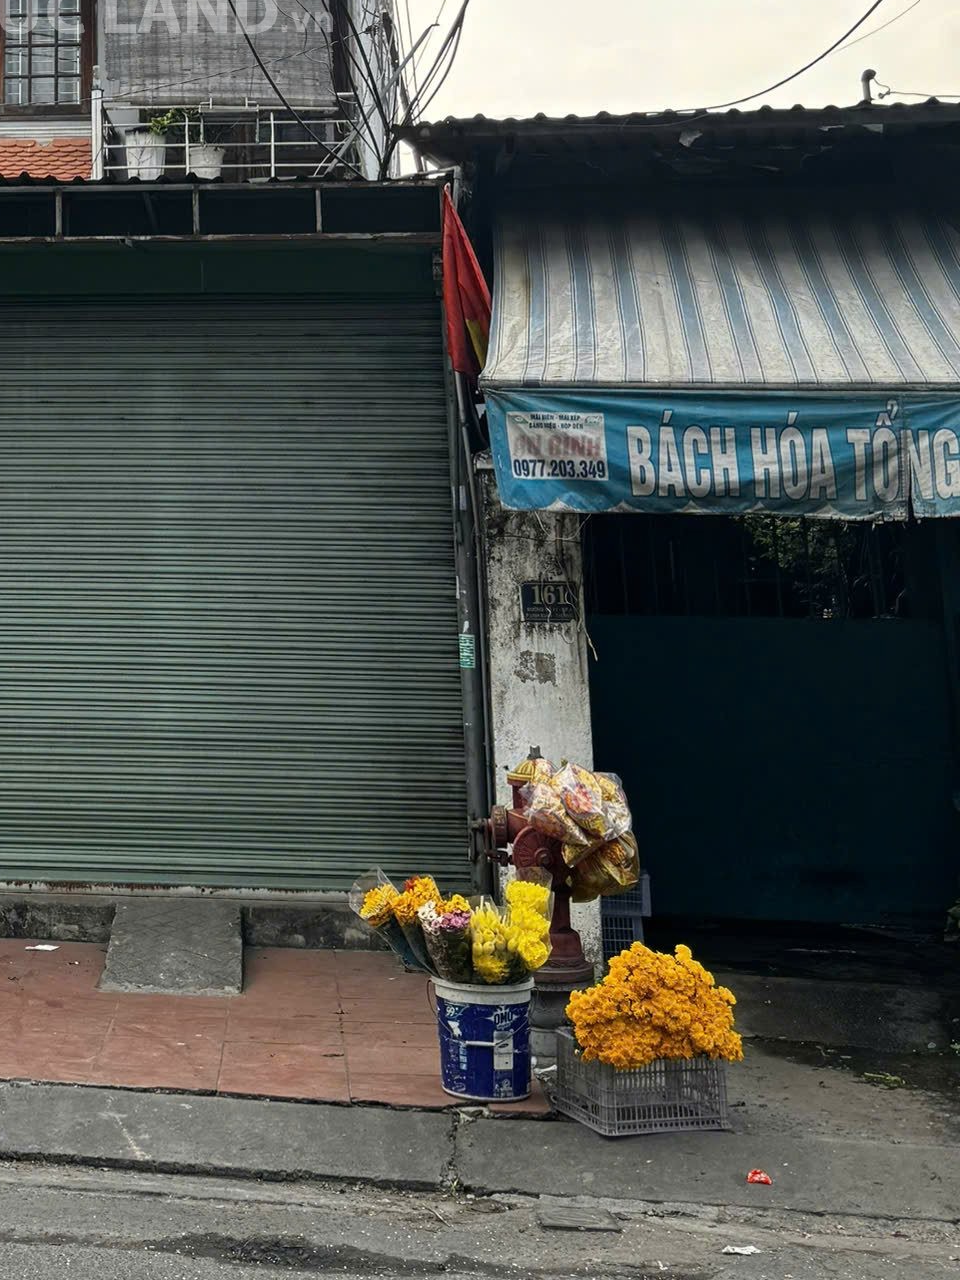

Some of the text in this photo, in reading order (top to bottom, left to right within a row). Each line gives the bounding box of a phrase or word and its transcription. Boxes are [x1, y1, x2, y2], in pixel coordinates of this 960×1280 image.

[626, 399, 960, 503] BÁCH HÓA TỔNG
[513, 459, 606, 479] 0977.203.349
[531, 585, 567, 605] 161
